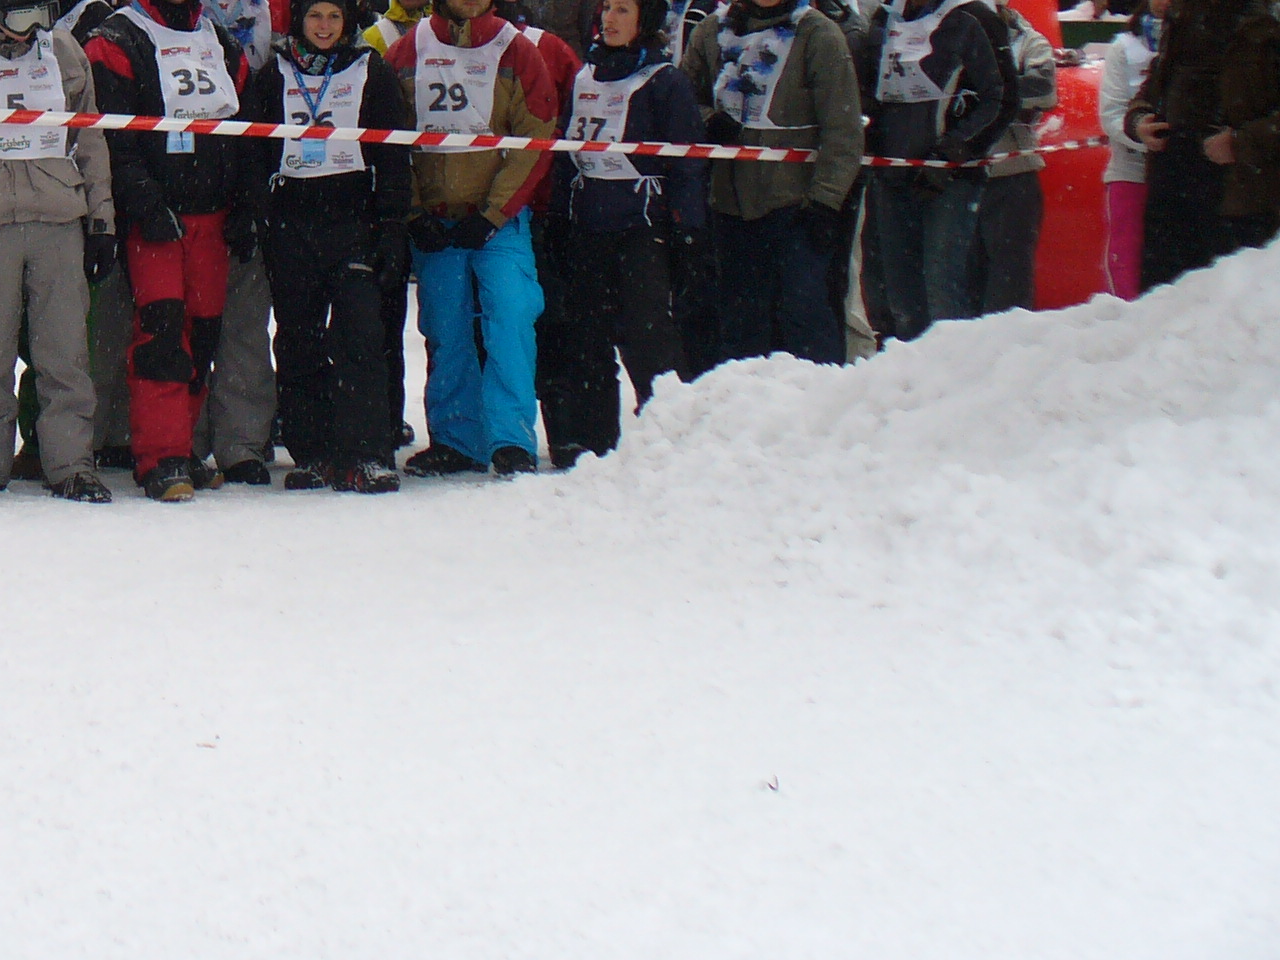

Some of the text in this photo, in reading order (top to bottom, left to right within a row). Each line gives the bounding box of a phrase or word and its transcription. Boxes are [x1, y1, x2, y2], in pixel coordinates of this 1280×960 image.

[171, 68, 217, 96] 35
[428, 82, 469, 112] 29
[572, 117, 607, 141] 37
